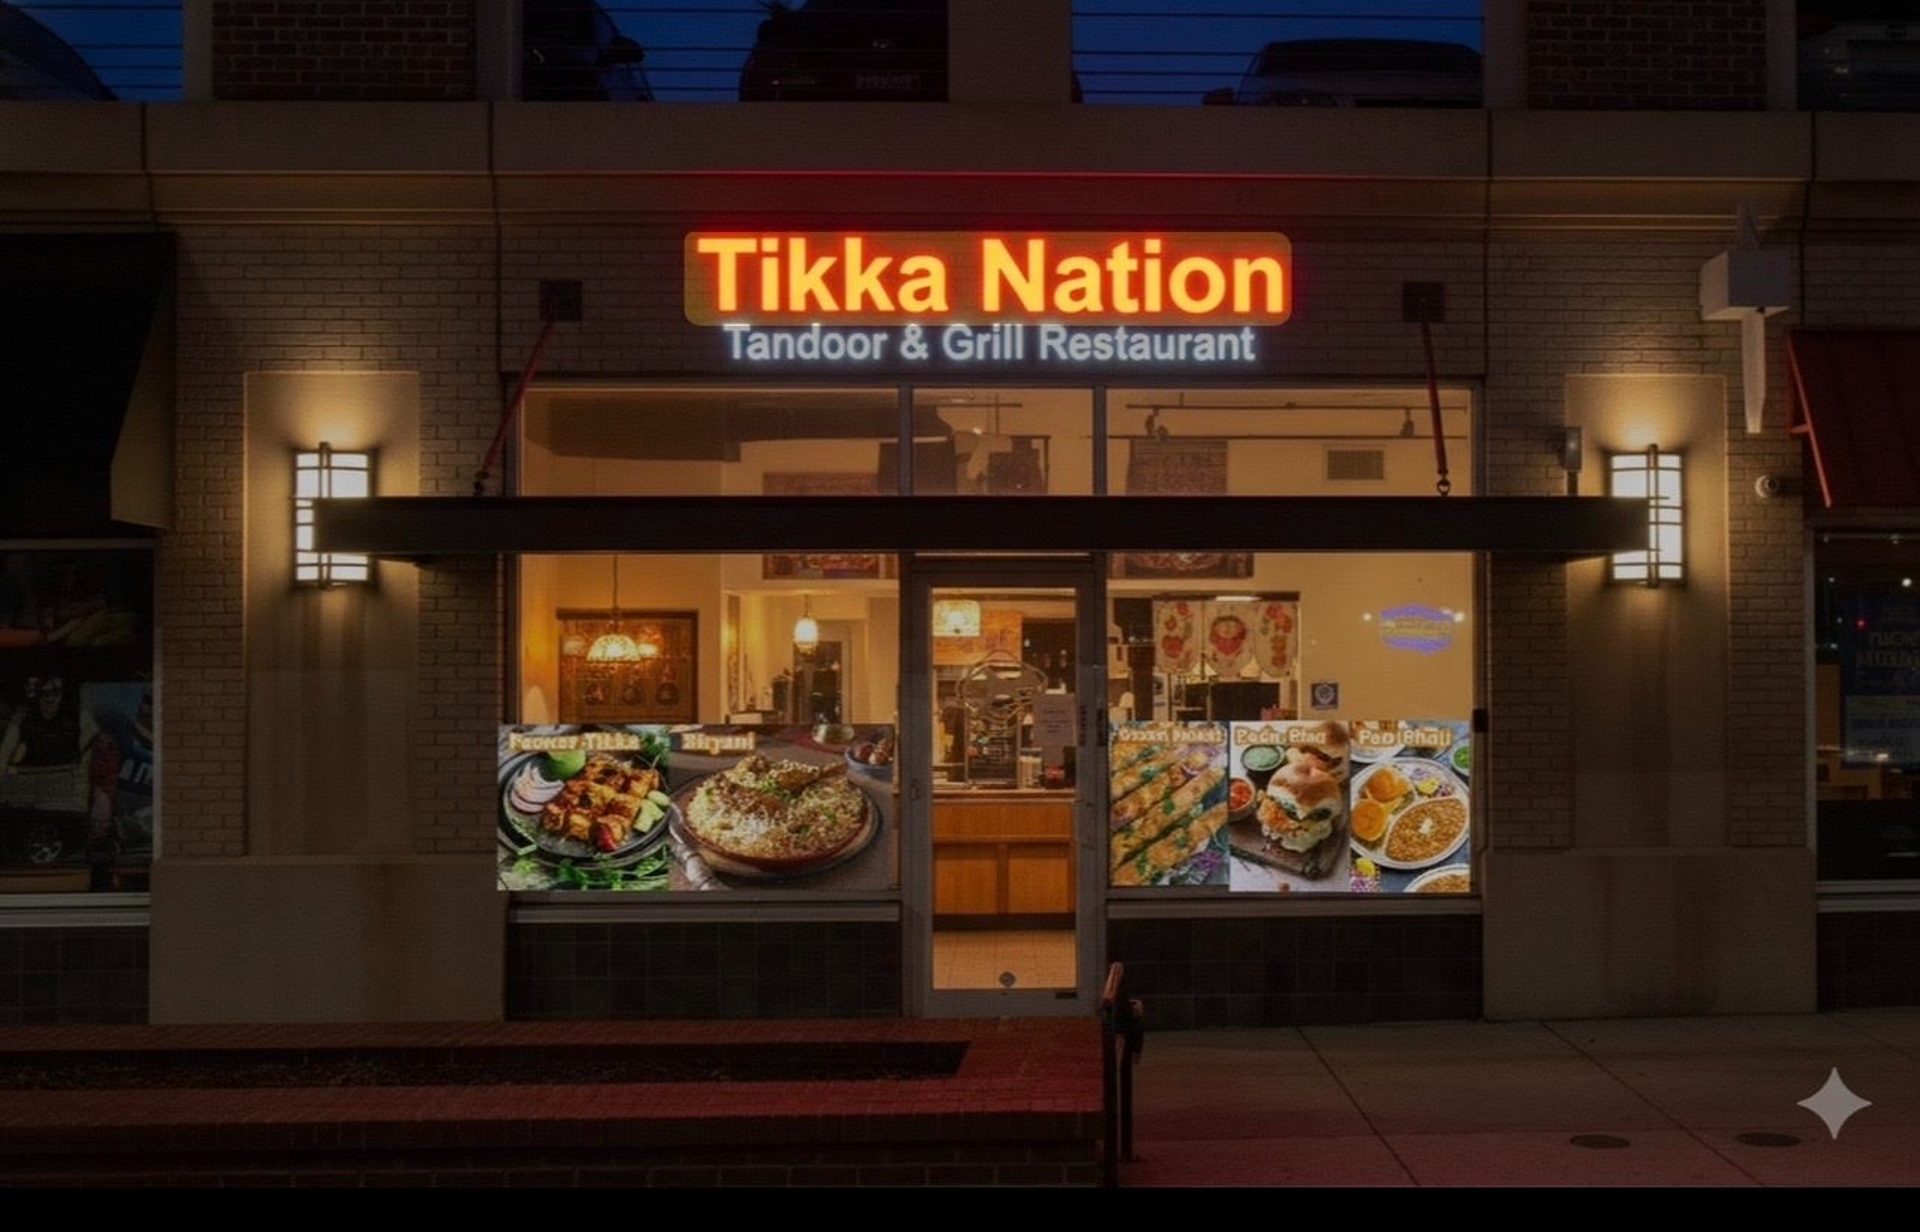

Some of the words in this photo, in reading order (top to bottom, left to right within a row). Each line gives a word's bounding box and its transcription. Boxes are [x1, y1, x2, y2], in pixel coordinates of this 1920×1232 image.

[697, 237, 948, 313] Tikka
[983, 238, 1285, 313] Nation
[724, 324, 888, 360] Tandoor
[899, 325, 929, 360] &
[942, 323, 1024, 360] Grill
[1040, 325, 1256, 361] Restaurant
